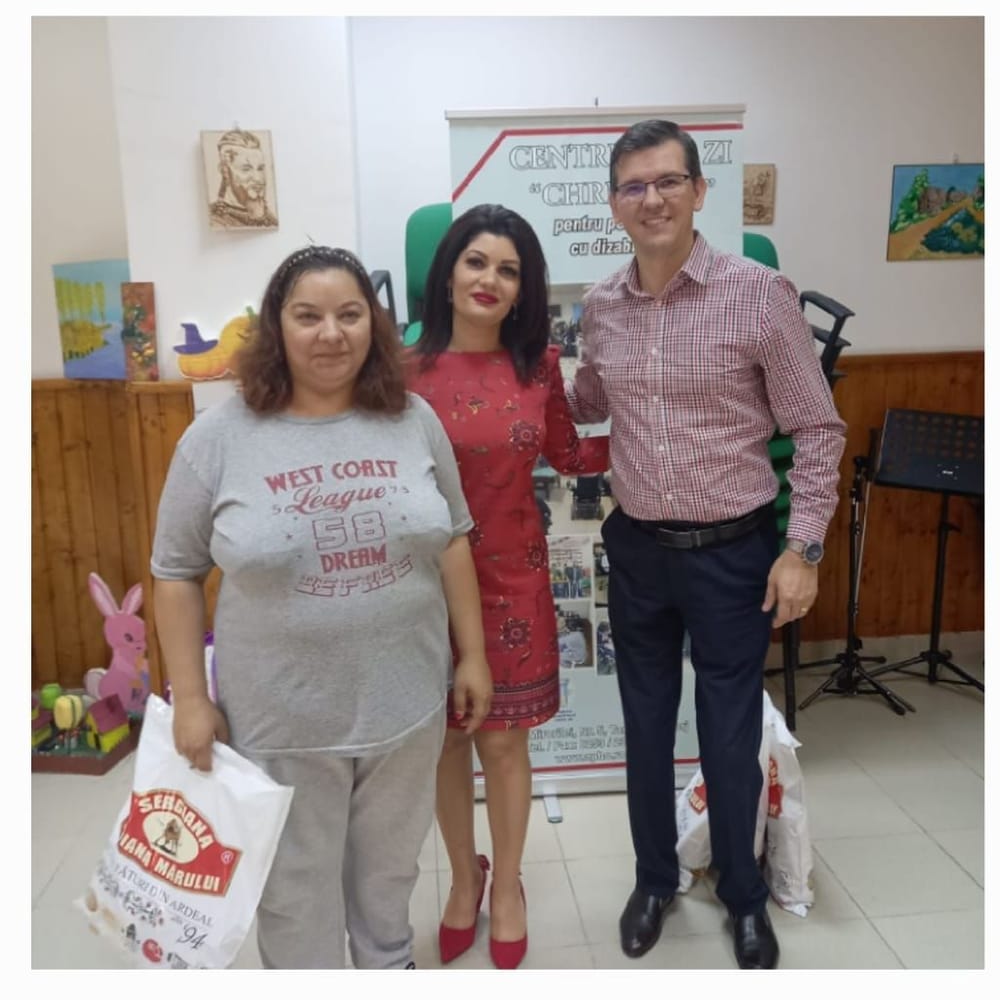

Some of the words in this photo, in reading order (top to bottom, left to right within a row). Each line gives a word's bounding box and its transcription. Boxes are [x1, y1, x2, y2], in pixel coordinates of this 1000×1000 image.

[508, 140, 612, 171] CENTR
[702, 139, 733, 166] ZI
[553, 215, 602, 235] pentru
[569, 242, 589, 256] cu
[264, 464, 324, 495] WEST
[330, 459, 398, 480] COAST
[284, 485, 387, 516] League
[311, 510, 387, 551] 58
[319, 543, 388, 574] DREAM
[138, 793, 214, 851] SERGIANA
[170, 900, 215, 928] ARDEAL
